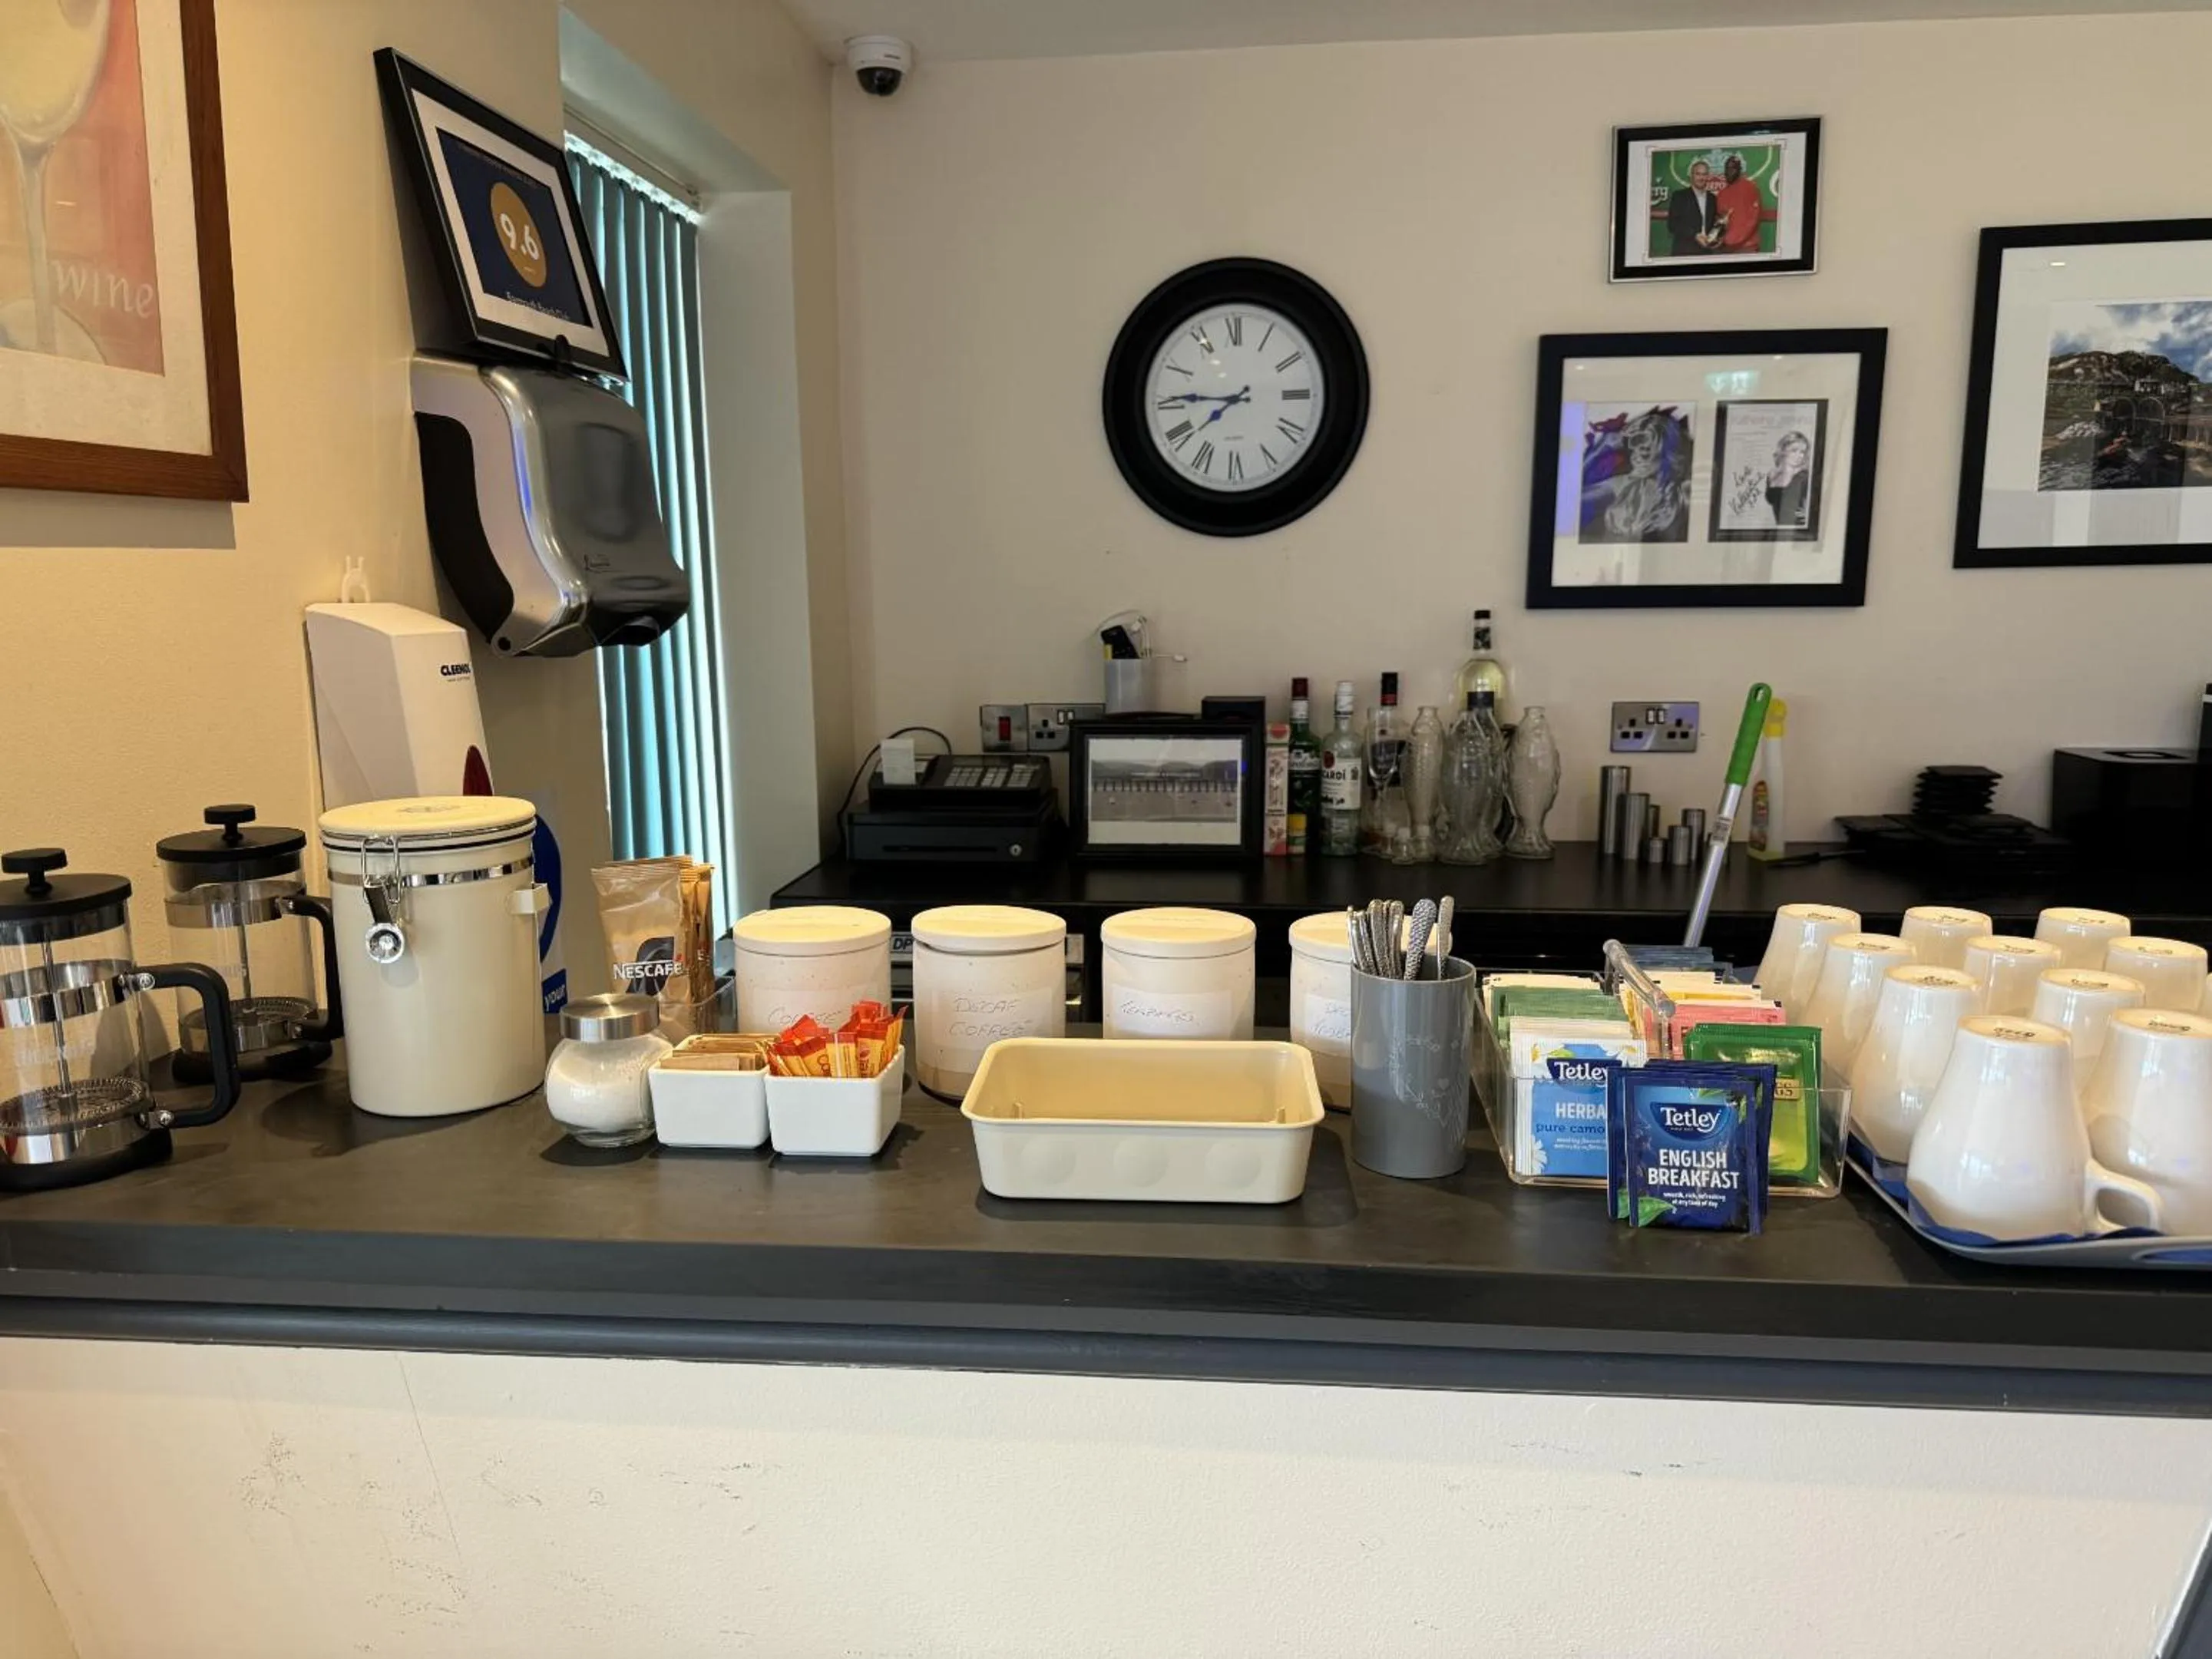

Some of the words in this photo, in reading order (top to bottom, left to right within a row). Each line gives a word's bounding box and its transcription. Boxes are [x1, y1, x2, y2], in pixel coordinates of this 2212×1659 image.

[501, 213, 539, 260] 9.6
[51, 259, 154, 319] wine
[1536, 1122, 1566, 1133] pure
[1660, 1107, 1721, 1132] Tetley
[1659, 1148, 1728, 1169] ENGLISH
[1648, 1168, 1741, 1189] BREAKFAST
